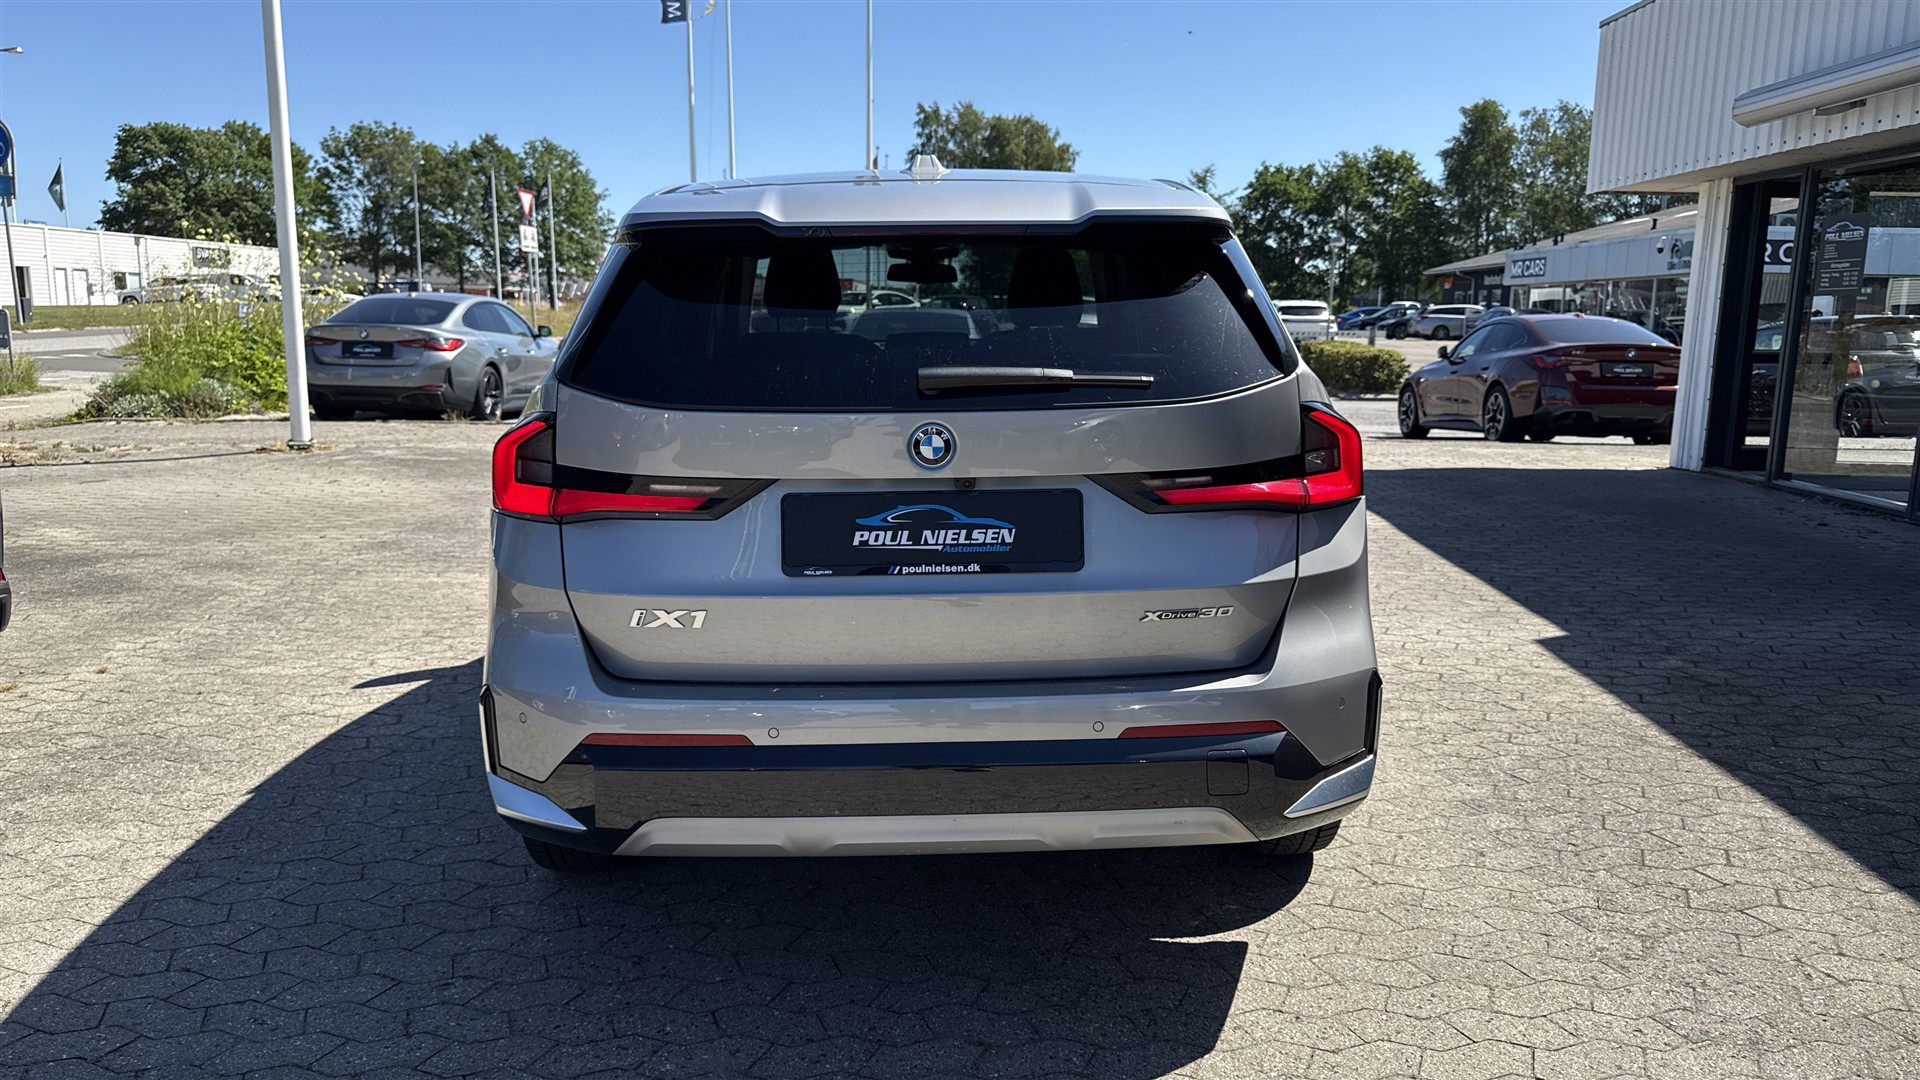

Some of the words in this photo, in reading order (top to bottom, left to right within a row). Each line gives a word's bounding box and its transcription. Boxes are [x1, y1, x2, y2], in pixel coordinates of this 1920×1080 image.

[1511, 261, 1523, 277] MR
[1523, 259, 1545, 276] CARS
[916, 427, 949, 441] BMW
[852, 530, 913, 546] POUL
[920, 528, 1016, 545] NIELSEN
[942, 545, 1012, 553] Automobiler
[902, 563, 981, 575] poulnielsen.dk
[629, 609, 707, 629] iX1
